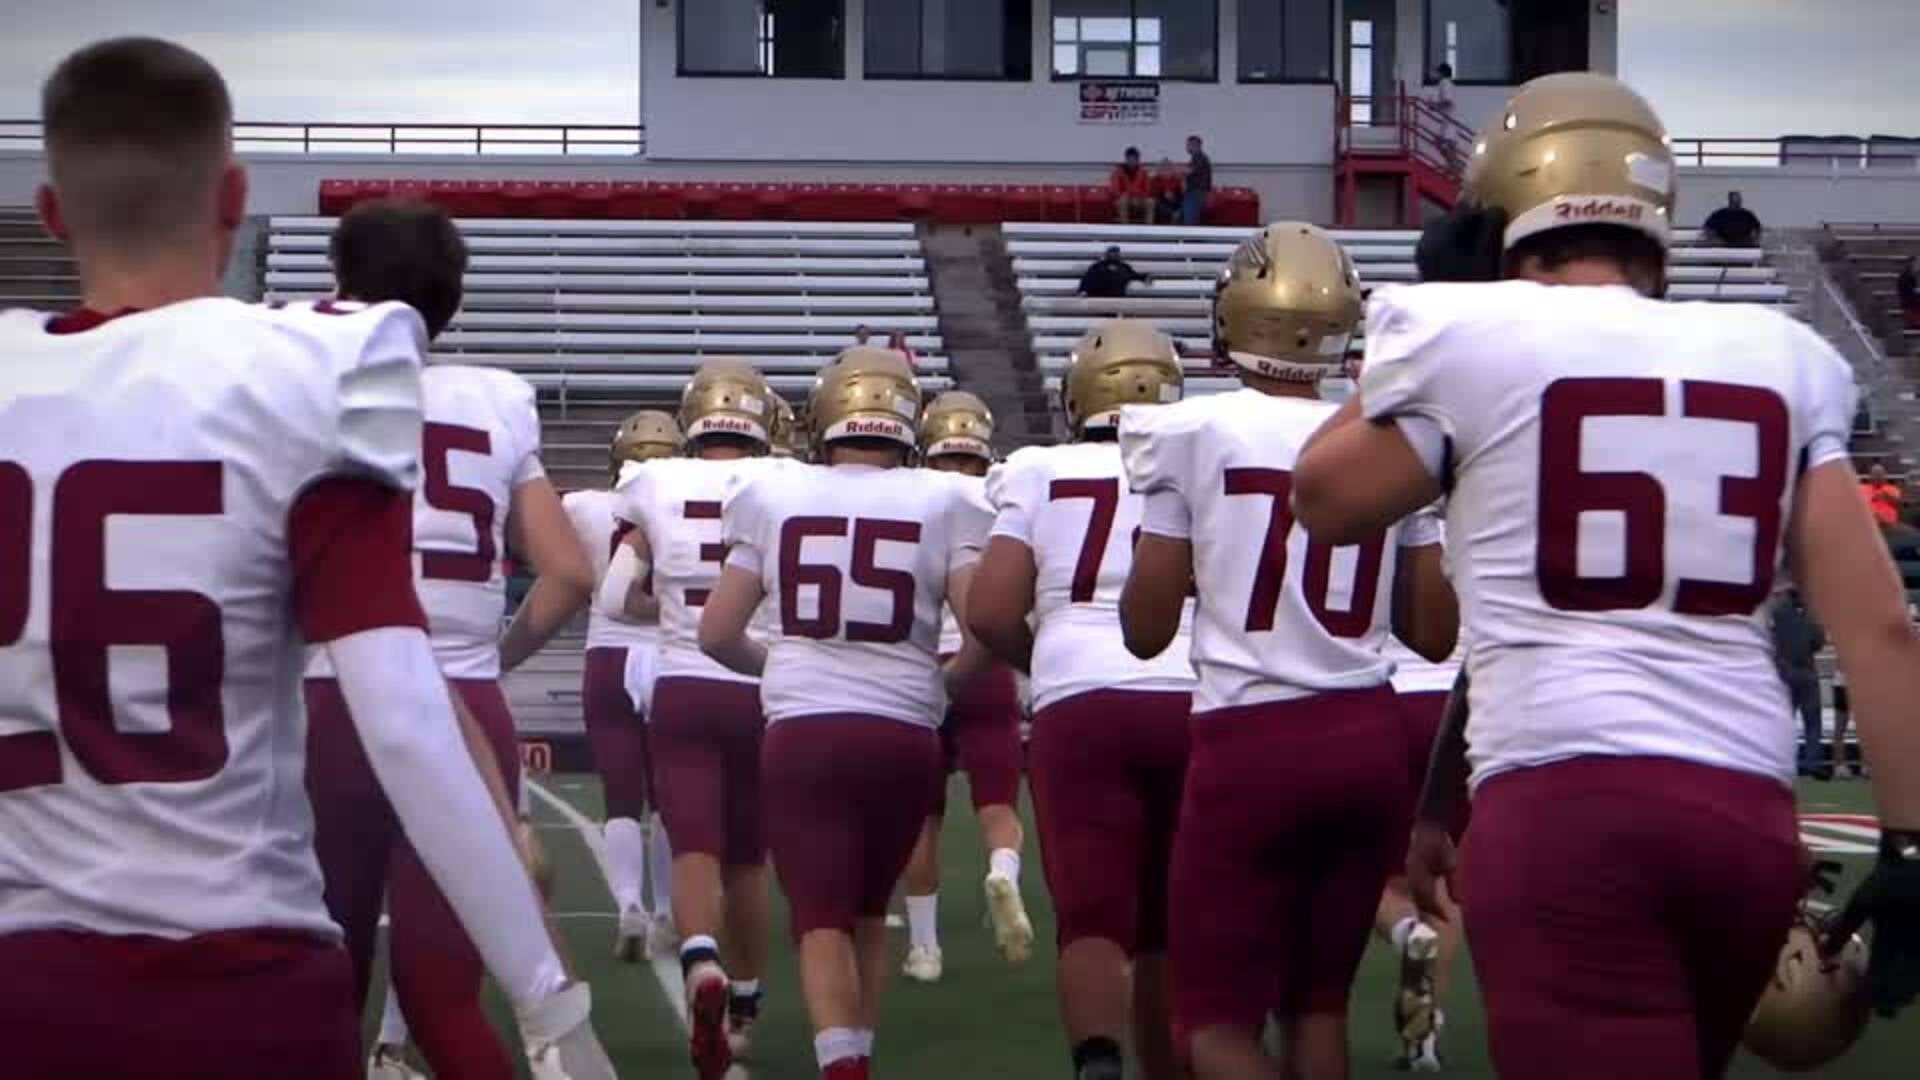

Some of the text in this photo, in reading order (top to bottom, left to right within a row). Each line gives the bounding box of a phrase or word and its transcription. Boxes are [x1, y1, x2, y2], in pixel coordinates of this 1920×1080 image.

[1554, 199, 1642, 219] Riddell
[846, 420, 903, 436] Riddell
[1257, 359, 1328, 382] Riddell
[1049, 476, 1141, 603] 7
[1223, 467, 1389, 638] 70
[1537, 376, 1790, 617] 63
[779, 515, 921, 644] 65
